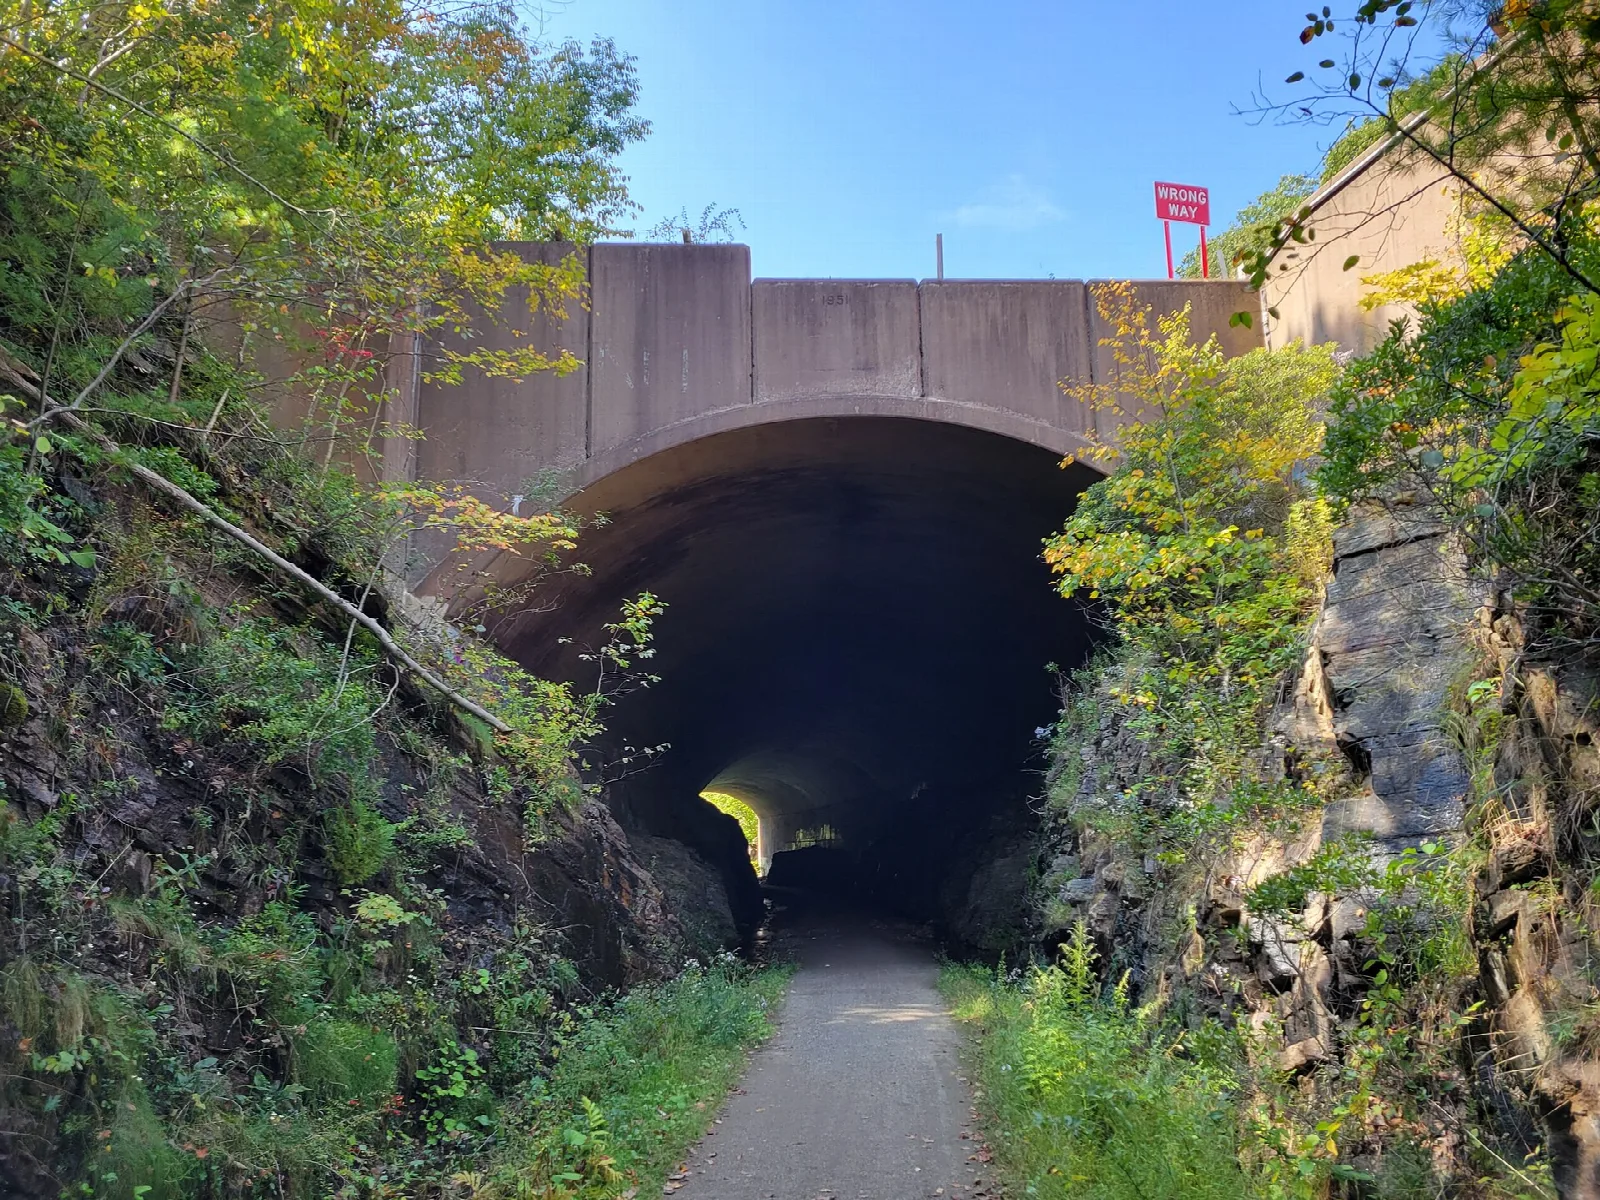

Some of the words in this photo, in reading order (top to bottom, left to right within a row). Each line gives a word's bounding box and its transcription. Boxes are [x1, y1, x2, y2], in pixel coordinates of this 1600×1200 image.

[1158, 186, 1207, 205] WRONG
[1168, 203, 1198, 219] WAY
[822, 295, 849, 305] 1951
